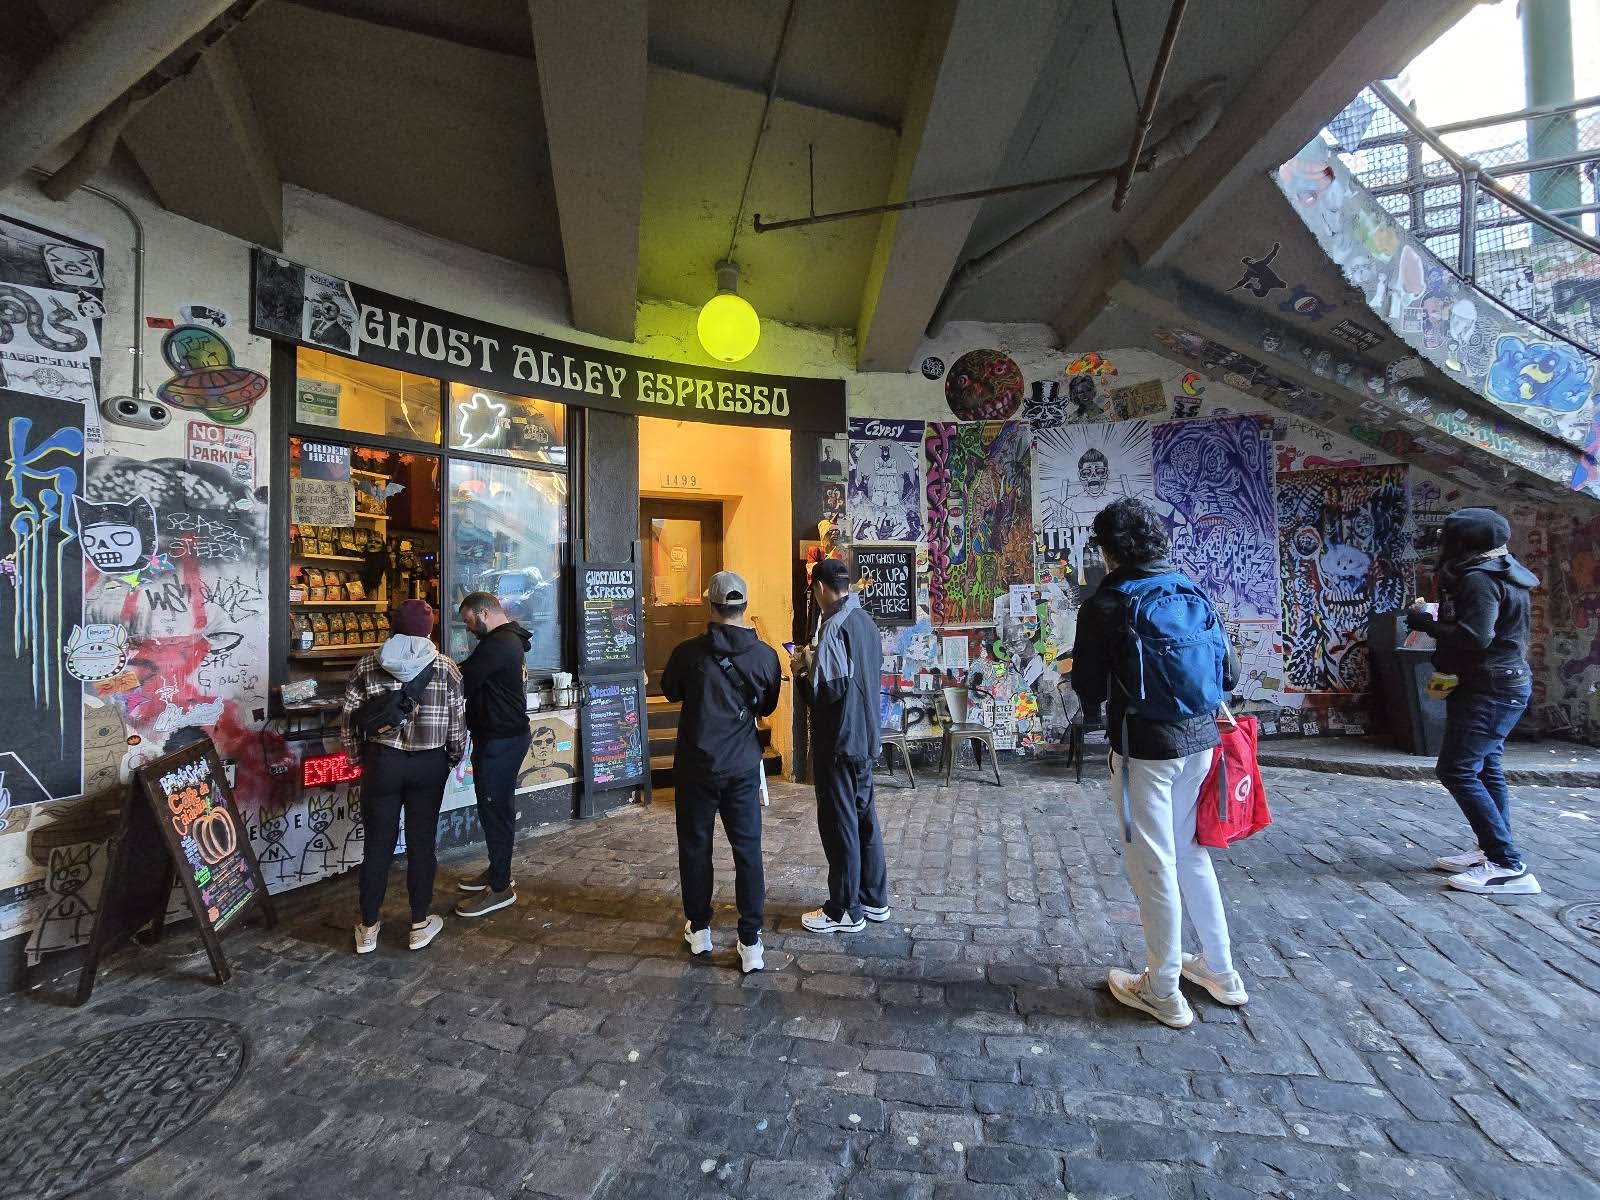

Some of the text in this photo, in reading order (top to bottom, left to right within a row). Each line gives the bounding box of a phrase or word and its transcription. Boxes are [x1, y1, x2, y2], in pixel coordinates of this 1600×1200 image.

[360, 303, 790, 417] GHOST ALLEY ESPRESSO
[192, 423, 220, 440] NO
[303, 443, 348, 456] ORDER
[309, 453, 344, 464] HERE
[666, 474, 697, 487] 1499
[876, 554, 896, 564] GHOST
[897, 554, 907, 564] US
[585, 570, 633, 585] GHOST ALLEY
[886, 568, 900, 581] UP
[585, 586, 634, 600] ESPRESSO
[865, 583, 907, 597] DRINKS
[880, 598, 910, 613] HERE!
